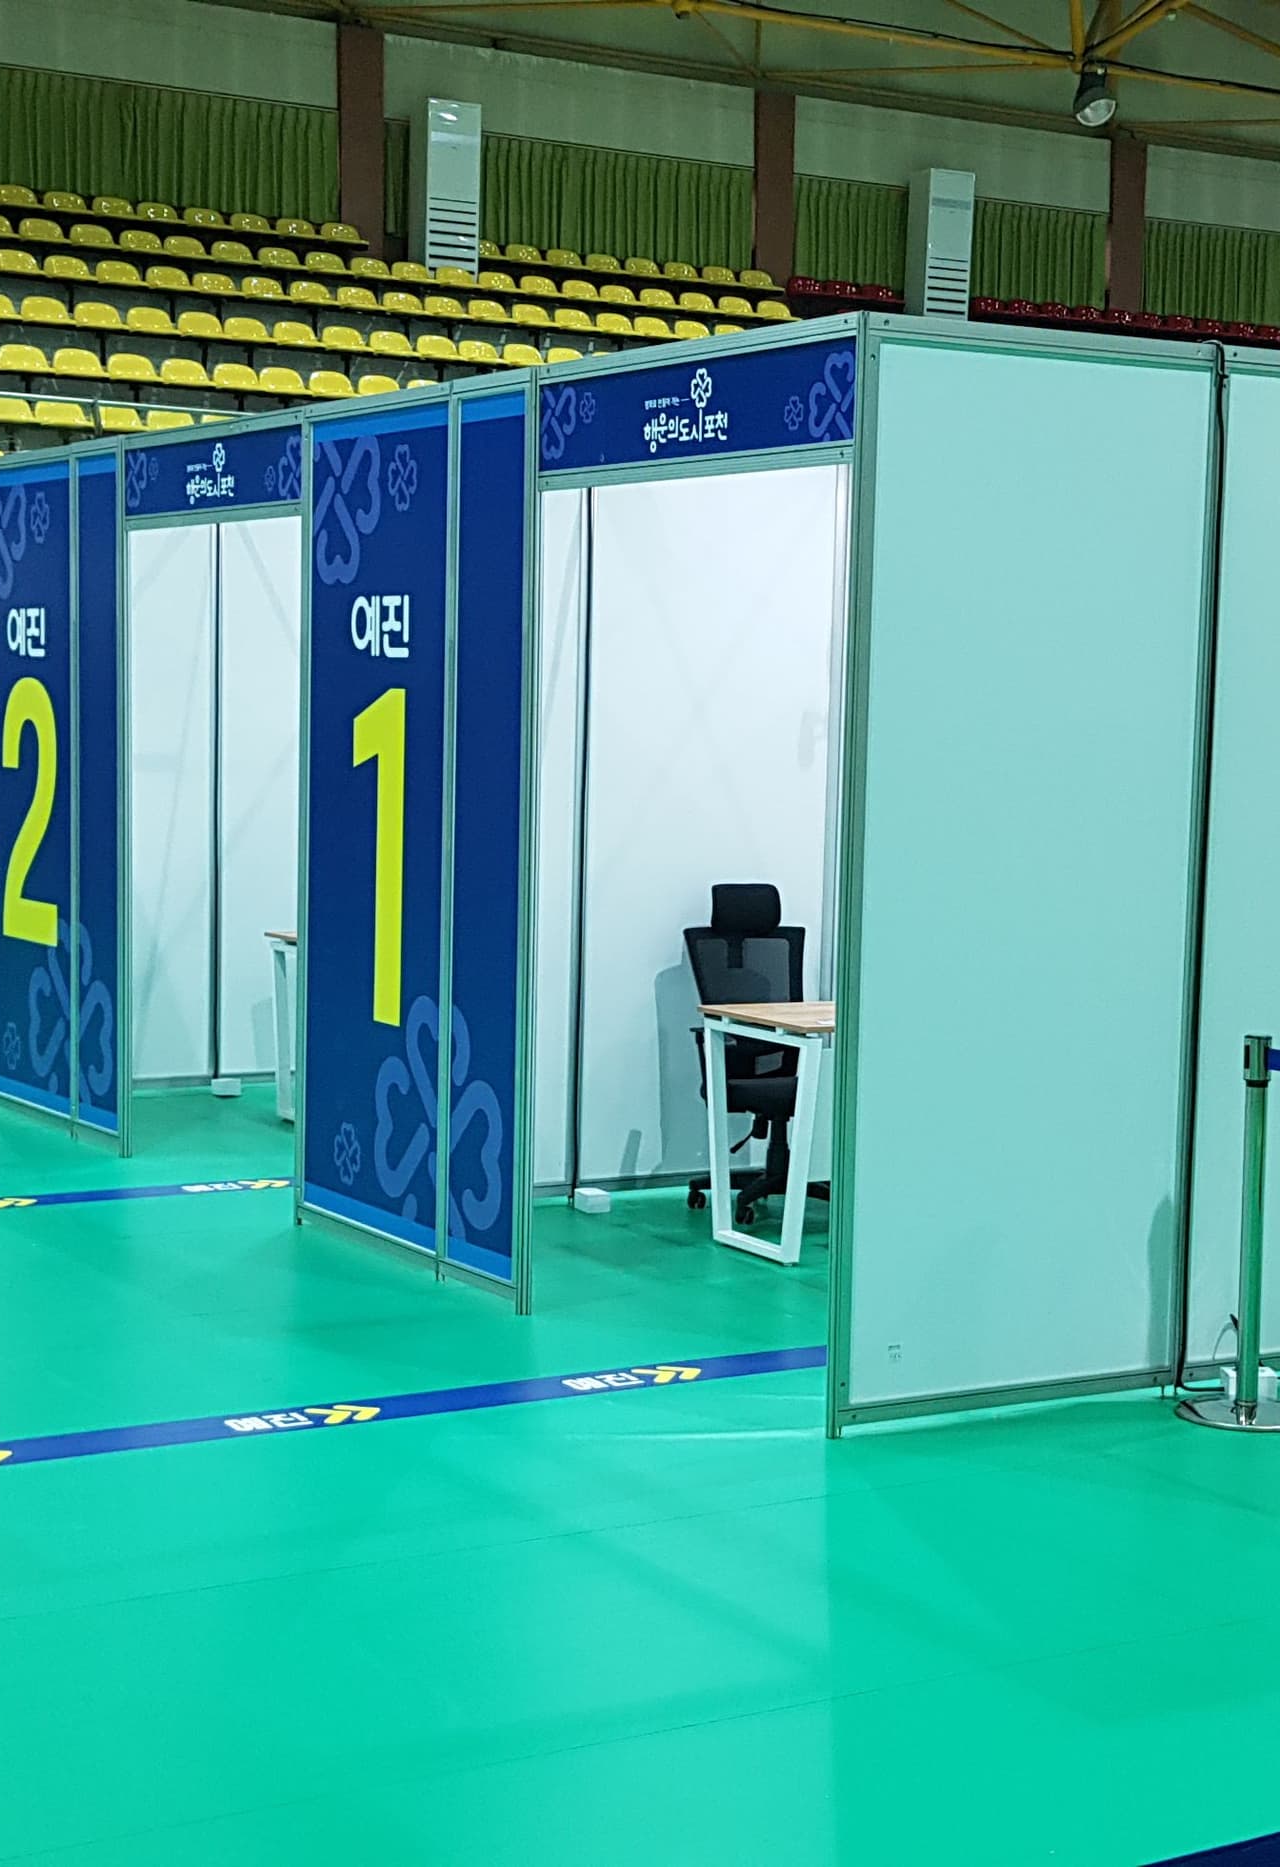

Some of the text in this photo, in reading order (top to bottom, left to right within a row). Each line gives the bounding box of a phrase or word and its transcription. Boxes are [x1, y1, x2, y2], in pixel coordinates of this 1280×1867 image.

[7, 608, 46, 658] 예진
[351, 595, 410, 658] 예진
[2, 677, 57, 946] 2
[353, 688, 406, 1026] 1
[223, 1412, 315, 1432] 예진
